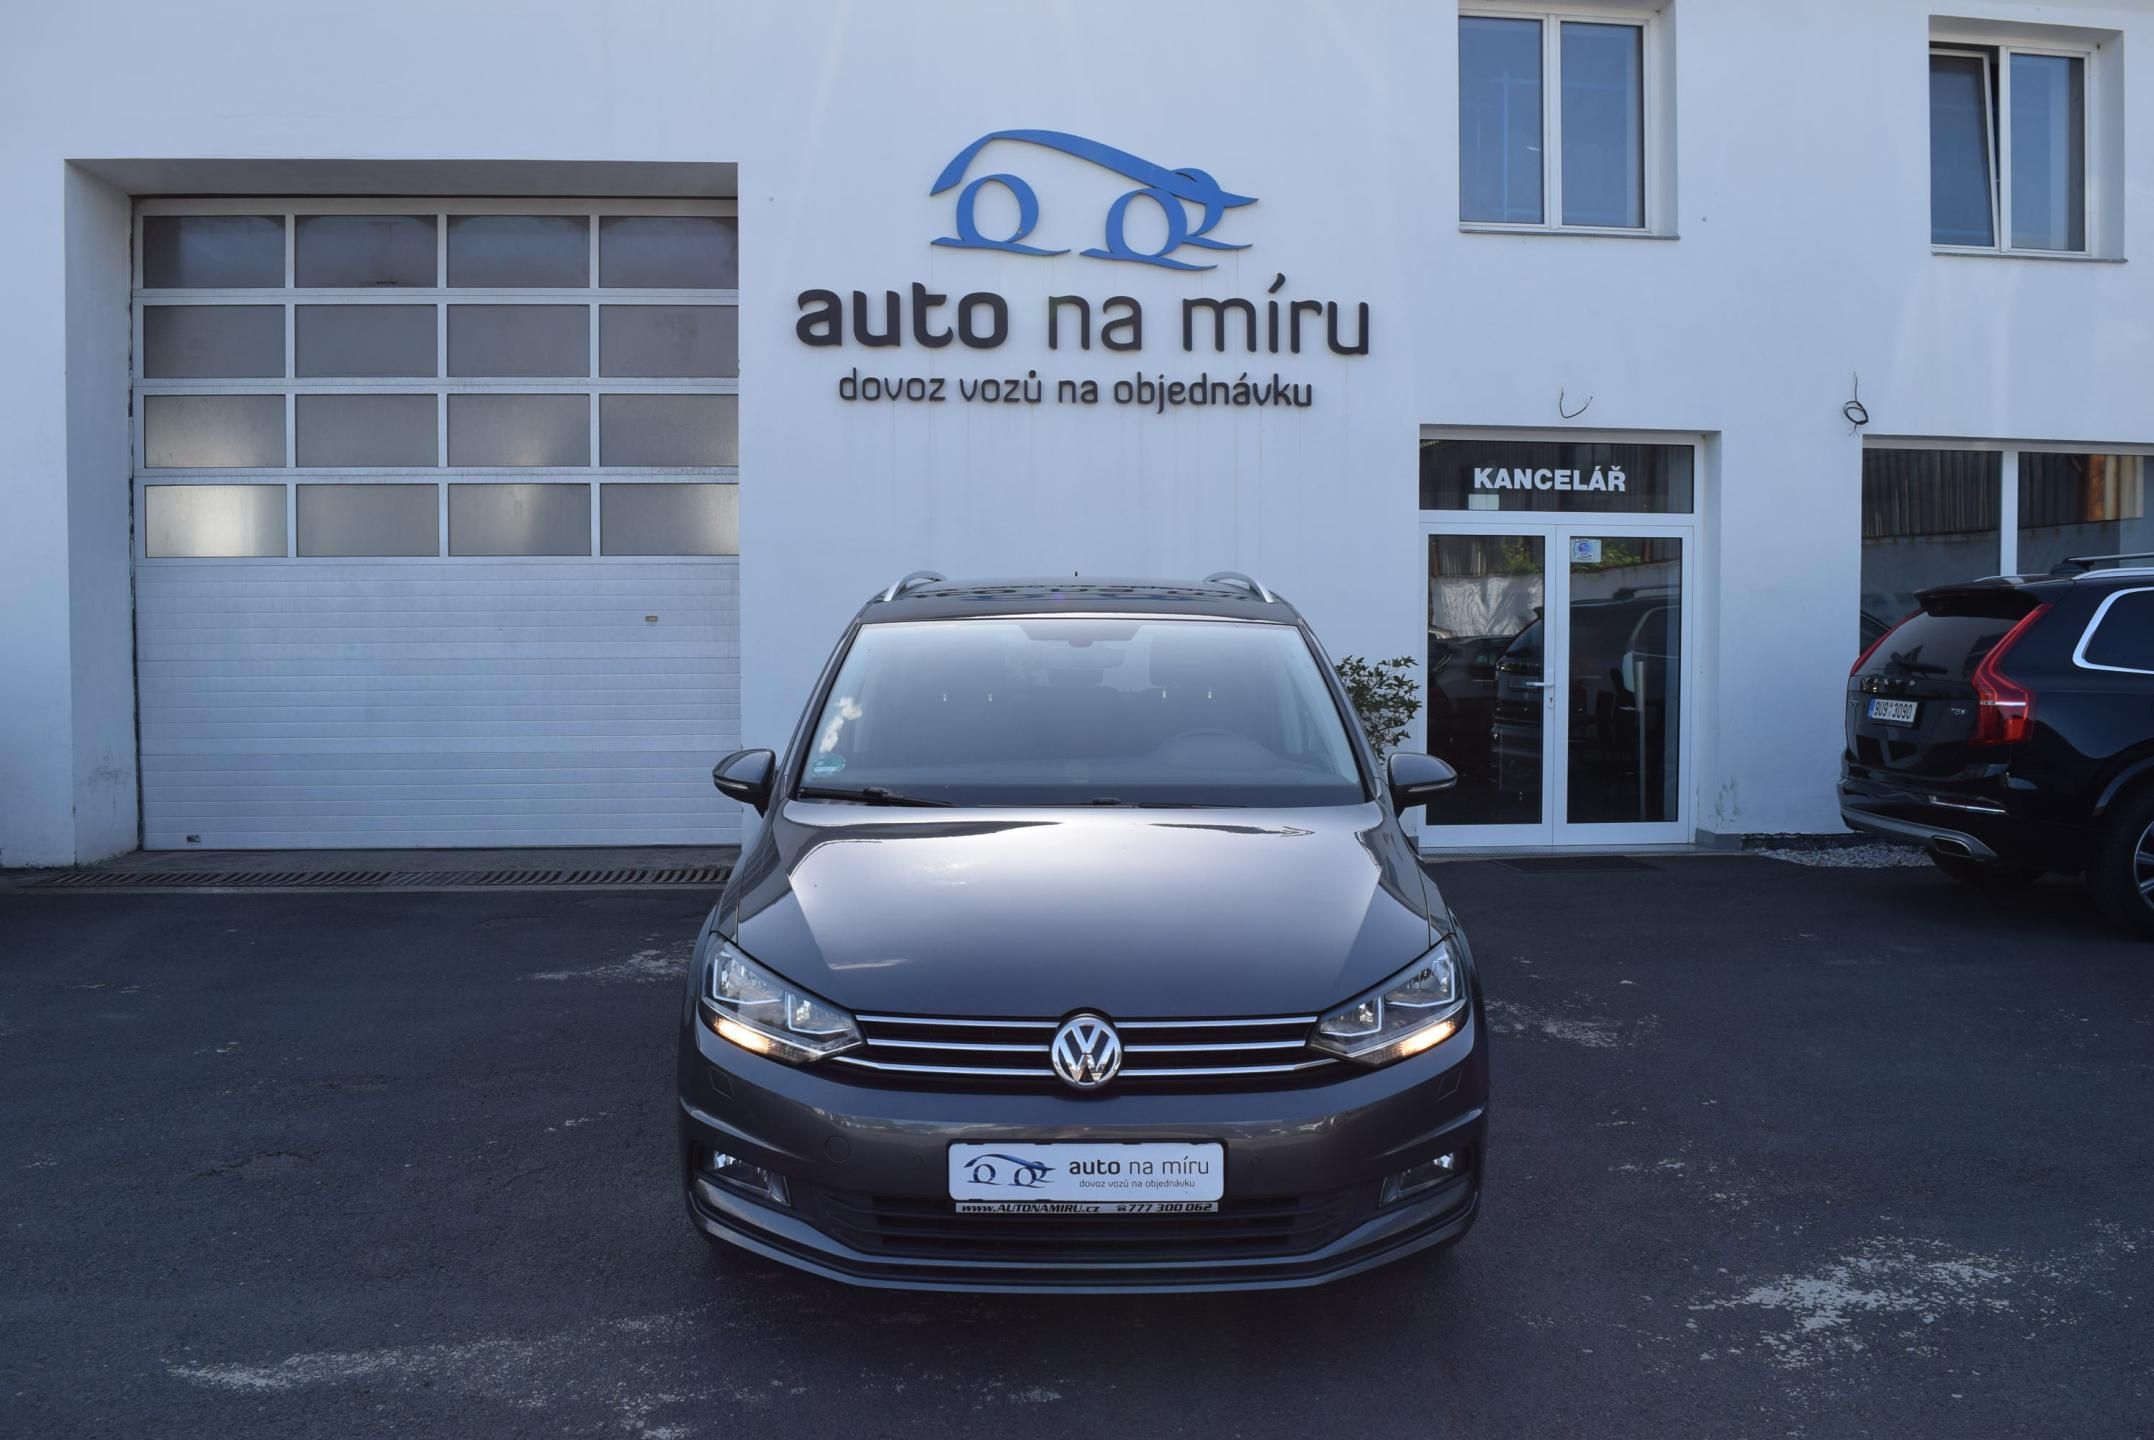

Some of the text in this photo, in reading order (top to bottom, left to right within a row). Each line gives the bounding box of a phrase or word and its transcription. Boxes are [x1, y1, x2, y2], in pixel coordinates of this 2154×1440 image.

[795, 272, 1370, 356] auto na míru
[838, 367, 1313, 415] dovoz vozů na objednávku
[1473, 465, 1627, 492] KANCELÁŘ
[1069, 1155, 1209, 1175] auto na míru
[1079, 1179, 1195, 1189] dovoz vozů na objednávku
[962, 1204, 1100, 1213] www.AUTONAMIRU.cz
[1156, 1203, 1183, 1212] 300
[1185, 1203, 1212, 1212] 062
